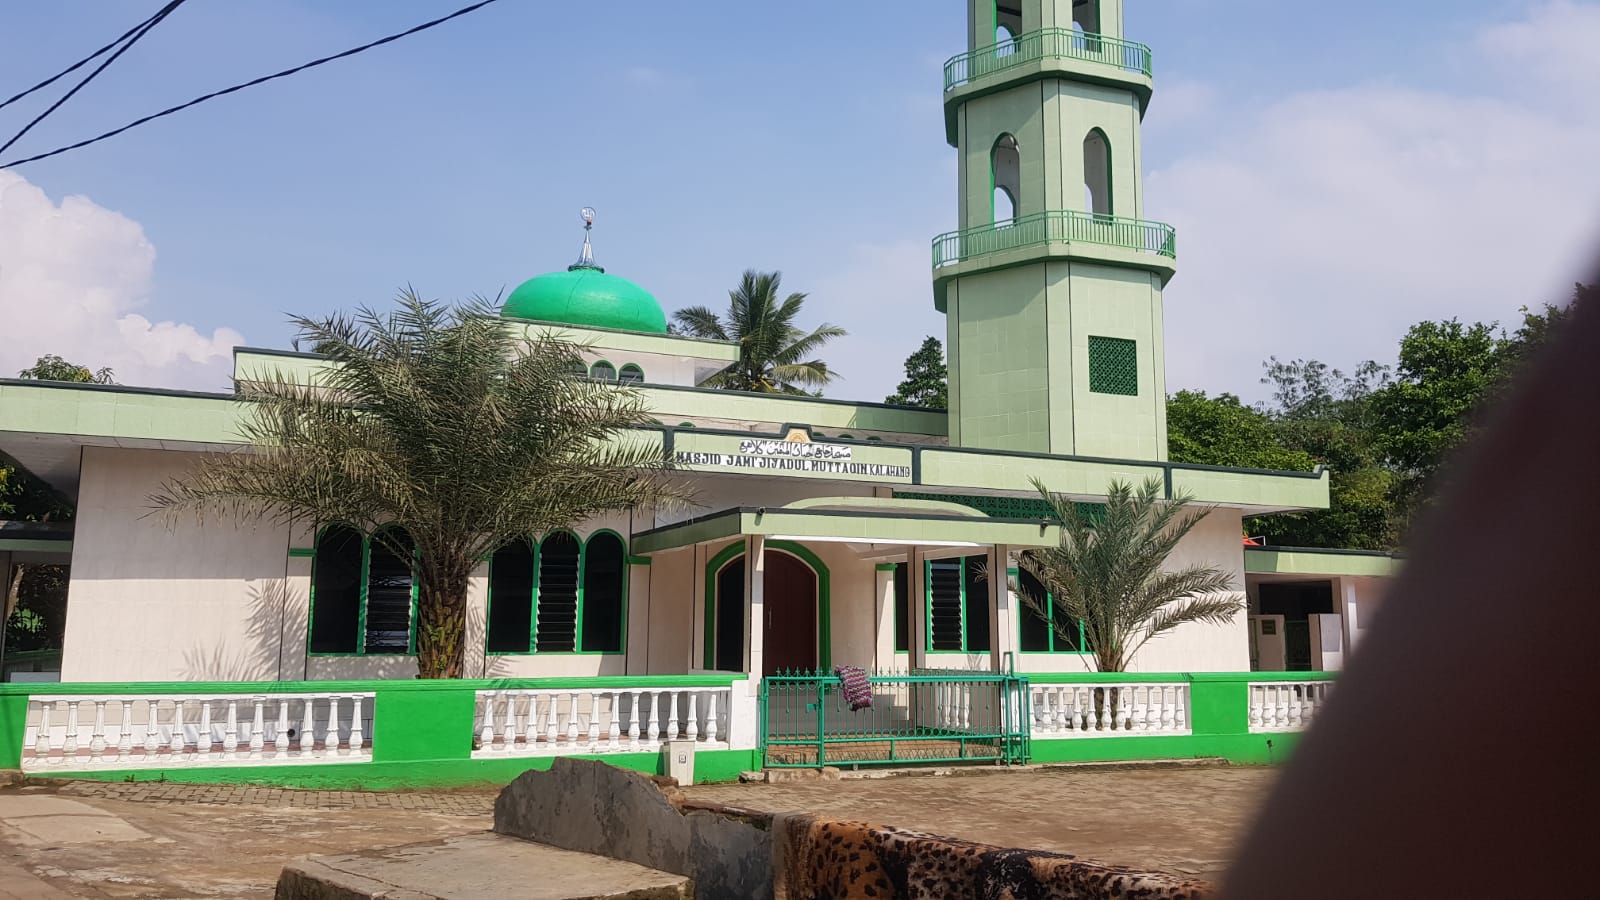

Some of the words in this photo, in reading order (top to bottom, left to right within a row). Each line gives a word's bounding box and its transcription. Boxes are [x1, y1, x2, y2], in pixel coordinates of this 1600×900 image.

[676, 451, 721, 465] MASJID
[759, 456, 809, 471] JIYADUL
[811, 460, 868, 475] MUTTAQIN
